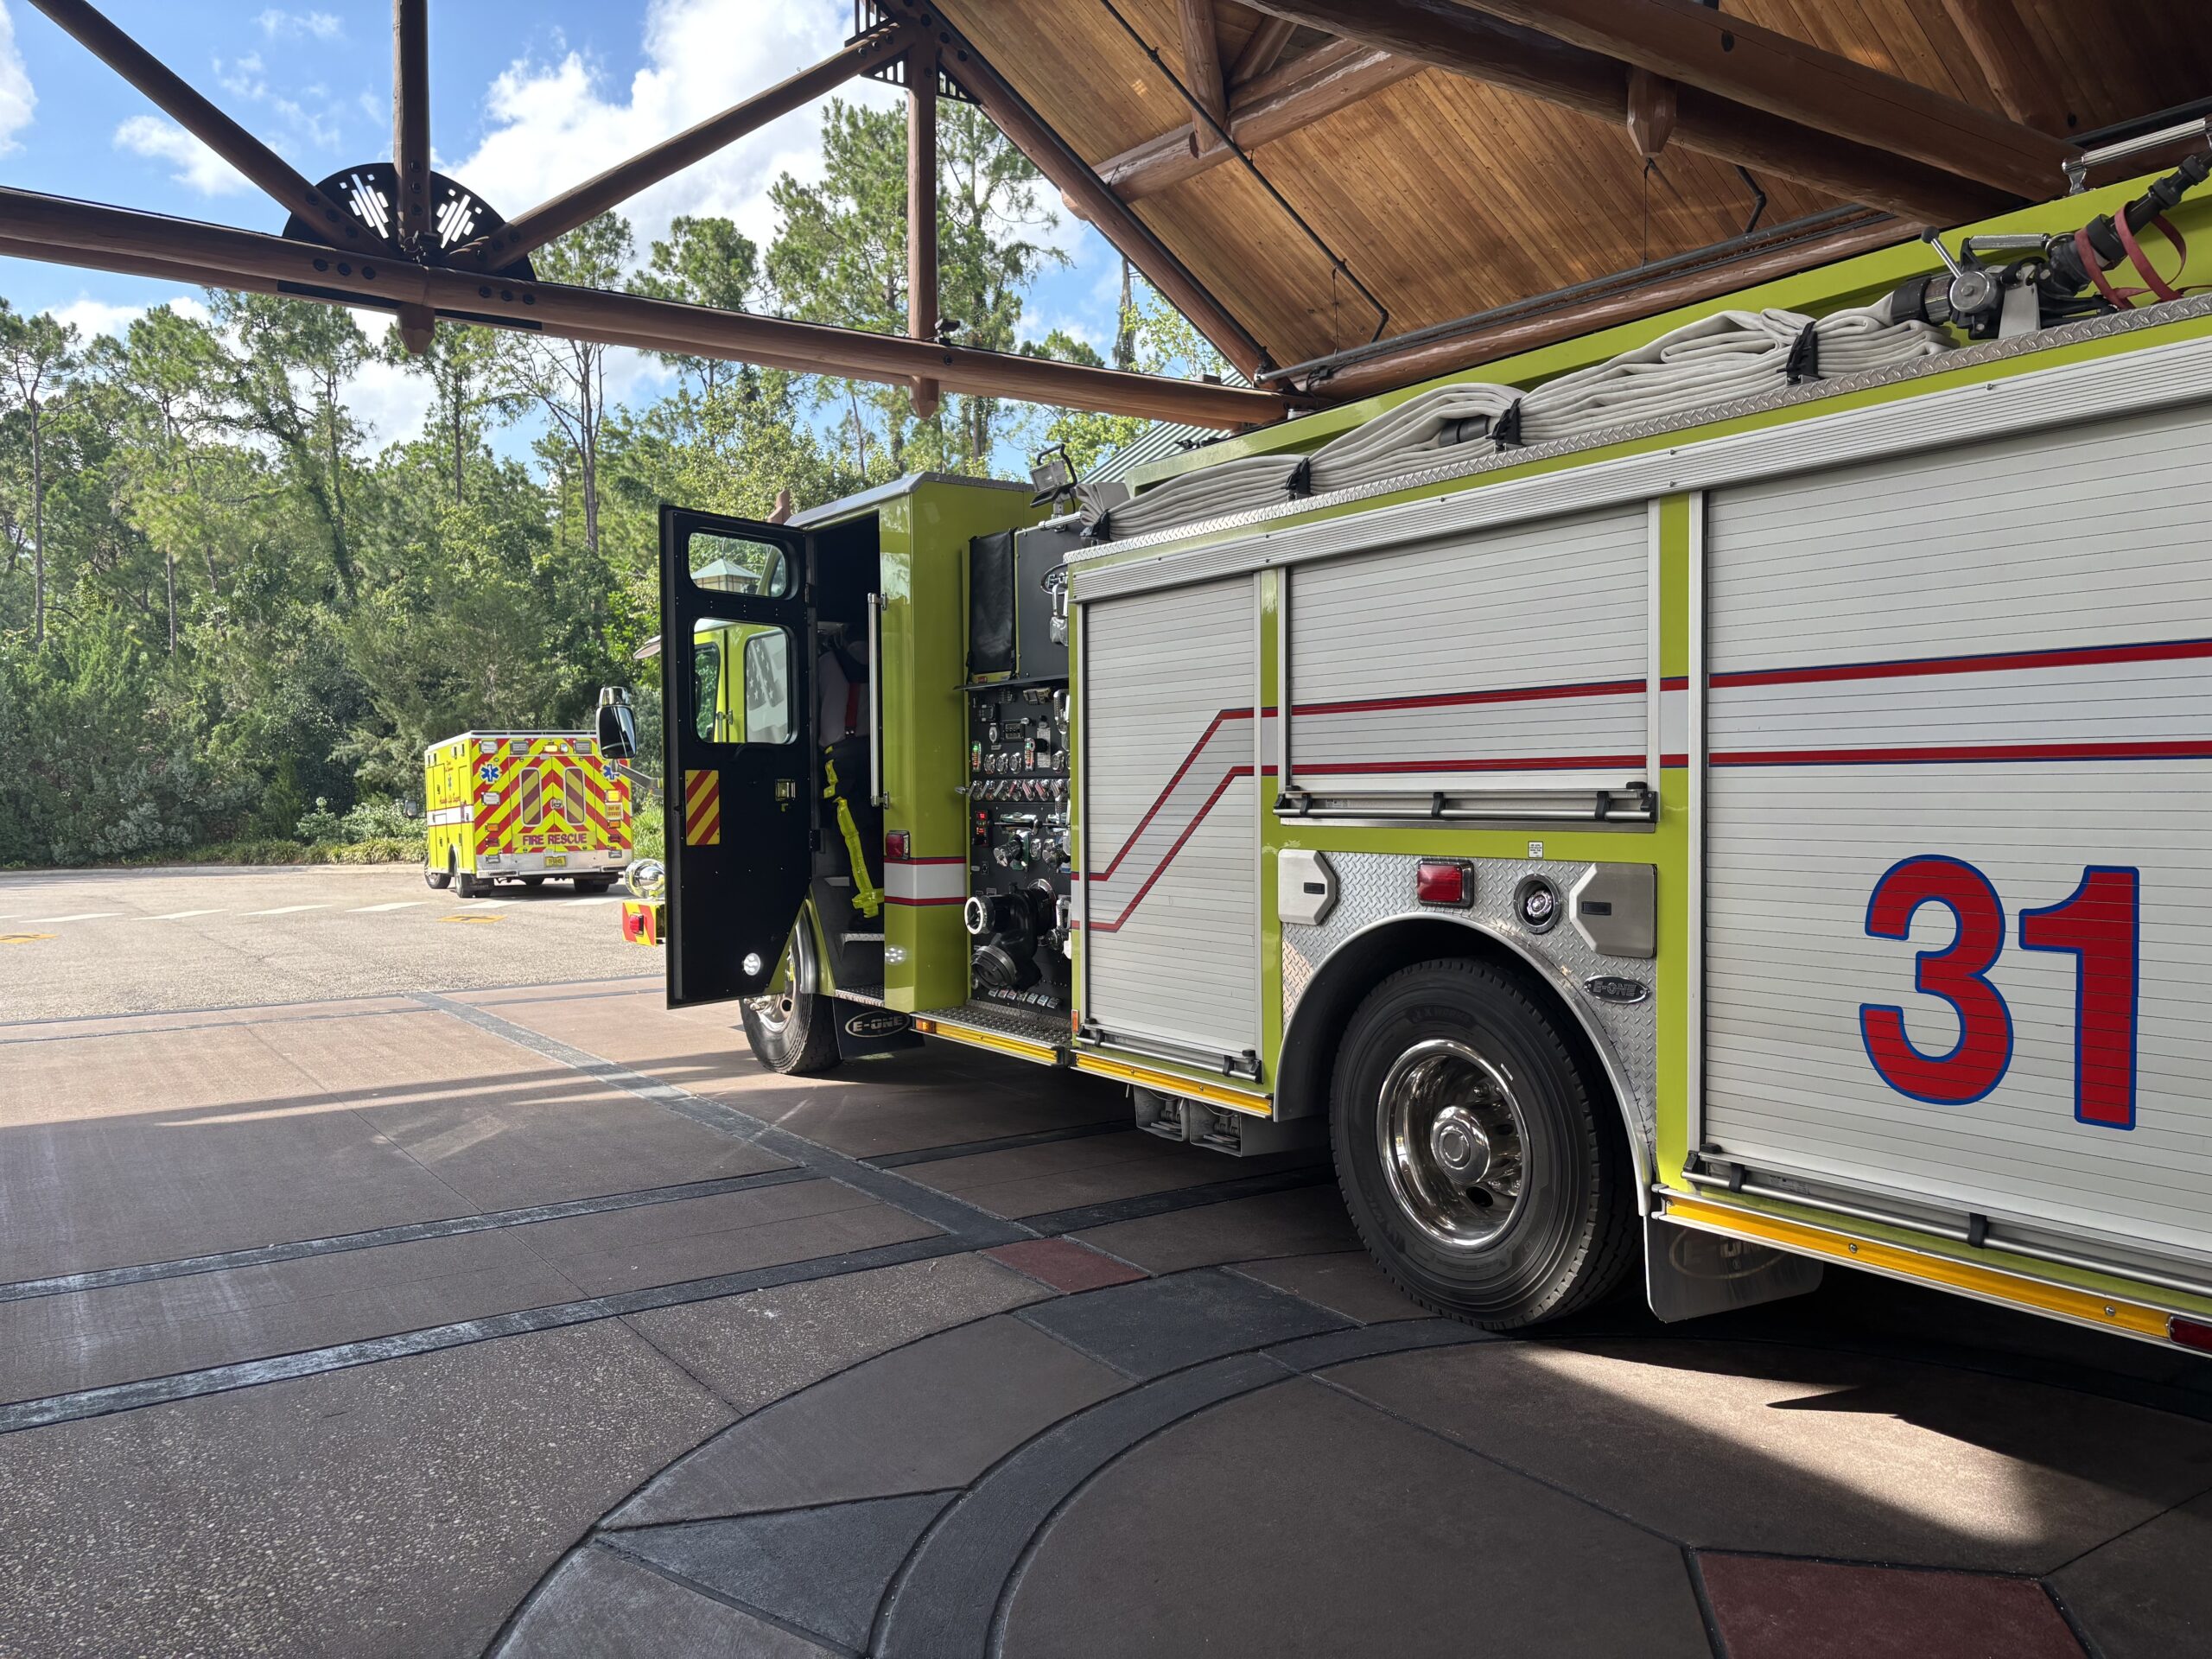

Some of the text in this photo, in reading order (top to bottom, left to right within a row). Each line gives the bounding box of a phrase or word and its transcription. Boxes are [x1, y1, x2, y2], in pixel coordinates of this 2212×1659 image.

[523, 833, 588, 846] FIRE RESCUE
[1592, 981, 1637, 997] E-ONE
[1859, 854, 2140, 1131] 31
[852, 1014, 905, 1033] E-ONE
